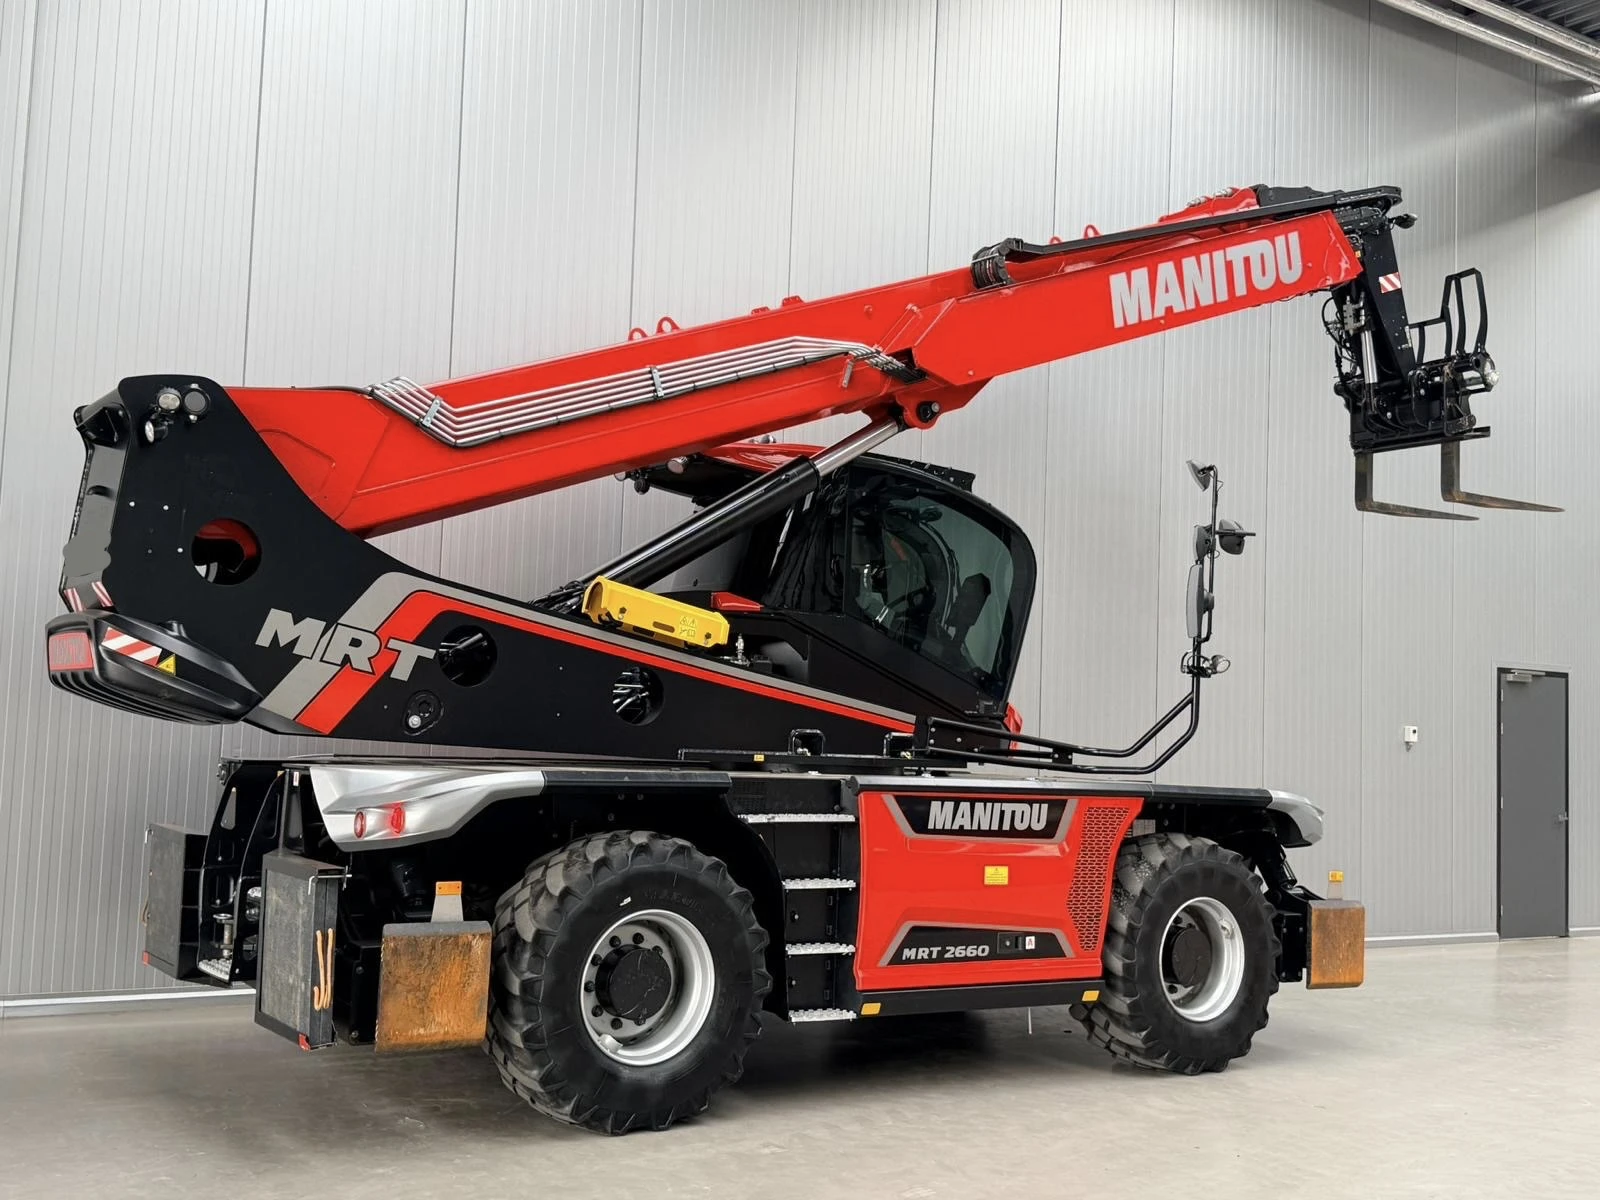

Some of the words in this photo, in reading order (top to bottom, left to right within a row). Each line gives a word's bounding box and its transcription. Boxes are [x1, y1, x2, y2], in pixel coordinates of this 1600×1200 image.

[1109, 231, 1303, 328] MANITOU
[255, 608, 437, 682] MRT
[928, 801, 1048, 831] MANITOU
[902, 946, 941, 960] MRT
[944, 945, 989, 959] 2660
